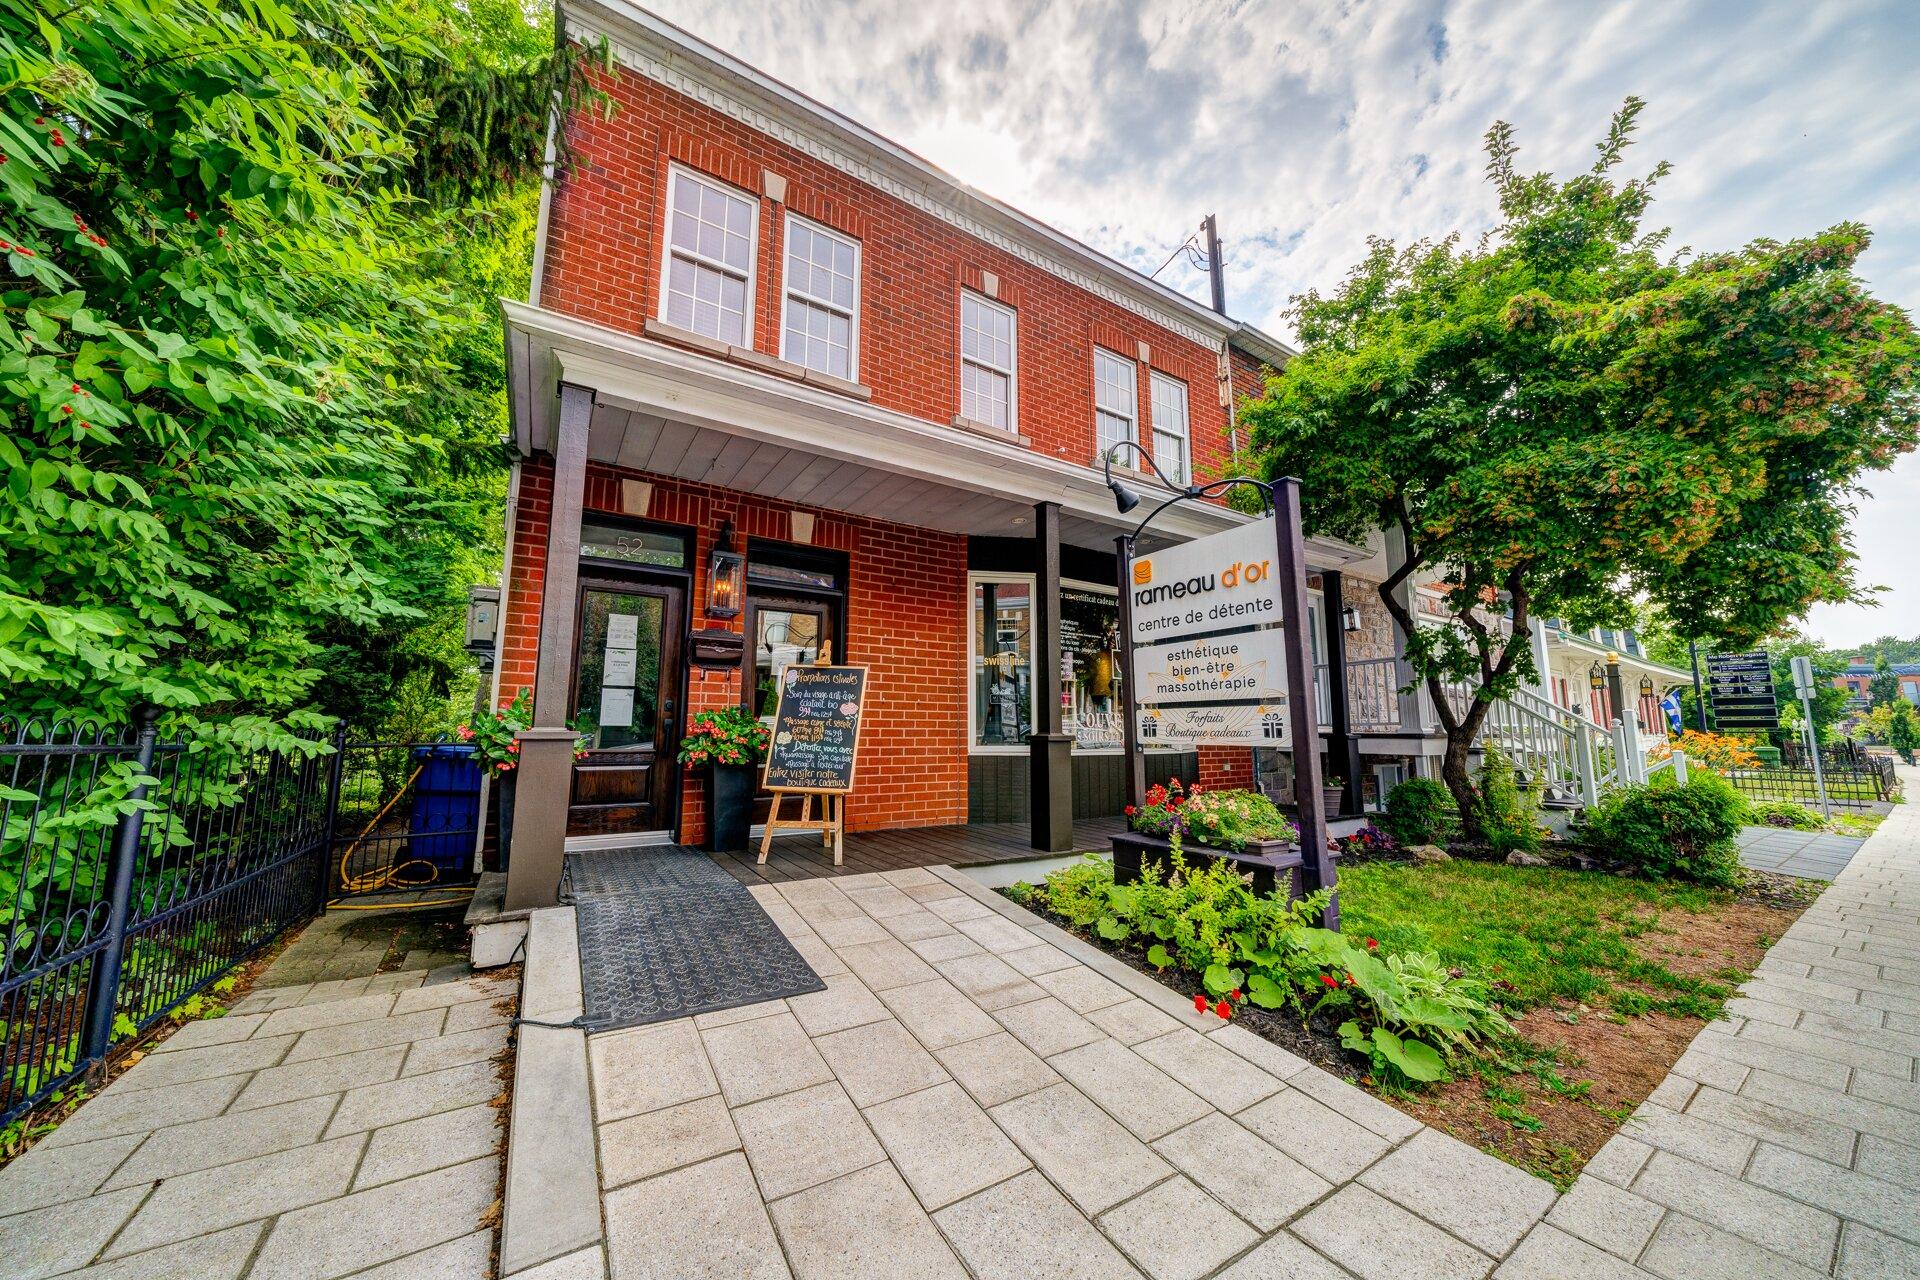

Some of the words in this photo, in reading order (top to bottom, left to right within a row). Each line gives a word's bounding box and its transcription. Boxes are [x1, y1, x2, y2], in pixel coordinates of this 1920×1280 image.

[617, 536, 643, 556] 52
[1135, 574, 1215, 607] rameau
[1221, 560, 1270, 588] d'or
[1073, 594, 1097, 604] certificat
[1097, 597, 1115, 606] cadeau
[1138, 614, 1180, 632] centre
[1185, 610, 1203, 625] de
[1208, 597, 1273, 621] détente
[1167, 643, 1239, 662] esthétique
[797, 669, 831, 685] Promotions
[1172, 662, 1235, 677] bien-être
[1157, 676, 1256, 693] massothérapie
[788, 690, 802, 699] Soin
[803, 690, 811, 698] du
[812, 690, 828, 700] visage
[1086, 712, 1123, 728] OUVE
[1186, 710, 1225, 728] Forfaits
[1165, 723, 1208, 742] Boutique
[1209, 724, 1251, 738] cadeaux
[838, 747, 853, 755] avec
[768, 766, 788, 778] Entrez
[790, 768, 815, 778] visiter
[816, 769, 839, 779] notre
[786, 777, 817, 787] boutique
[819, 778, 847, 788] cadeaux
